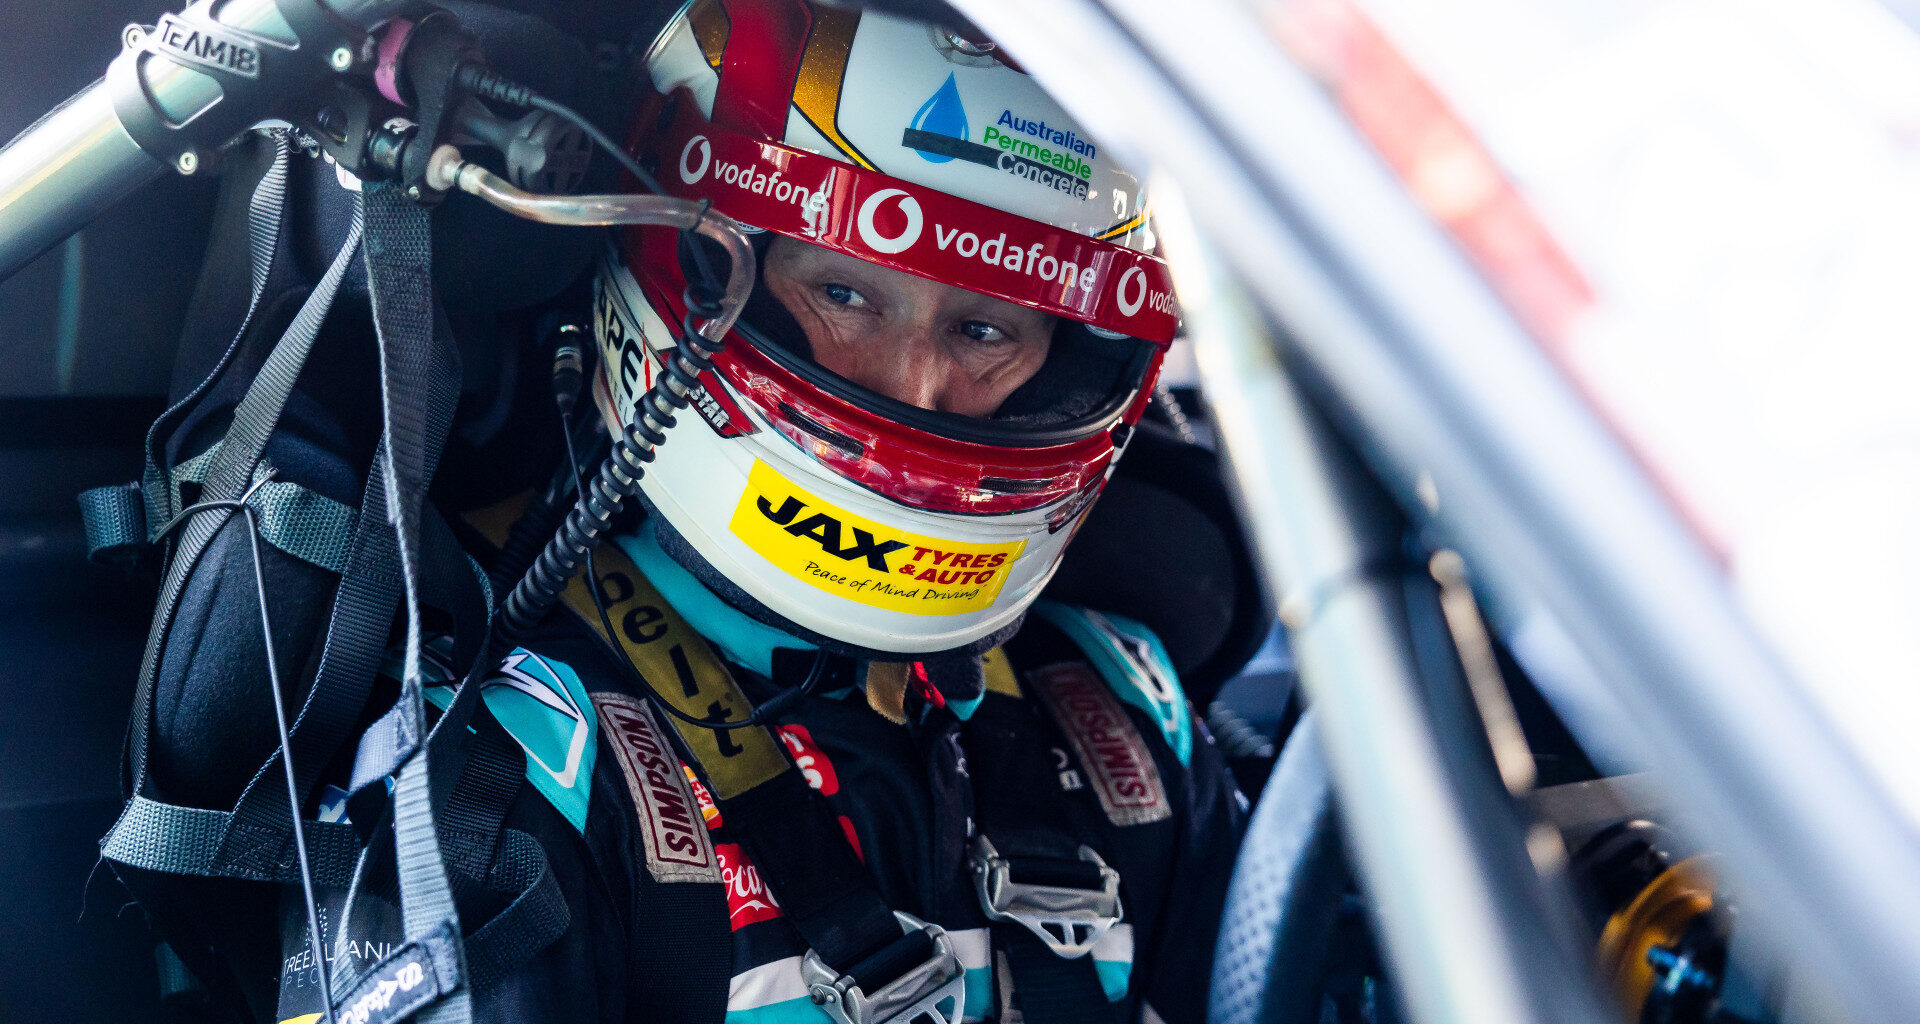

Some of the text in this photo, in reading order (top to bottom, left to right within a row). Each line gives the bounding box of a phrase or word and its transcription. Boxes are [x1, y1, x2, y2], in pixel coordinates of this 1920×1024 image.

[162, 20, 256, 72] TEAM18
[983, 126, 1092, 179] Permeable
[997, 109, 1096, 160] Australian
[714, 159, 827, 212] vodafone
[997, 151, 1088, 201] Concrete
[935, 223, 1097, 293] vodafone
[756, 494, 1009, 573] JAX TYRES
[803, 560, 980, 601] Peace of Mind Driving
[613, 713, 699, 858] SIMPSON
